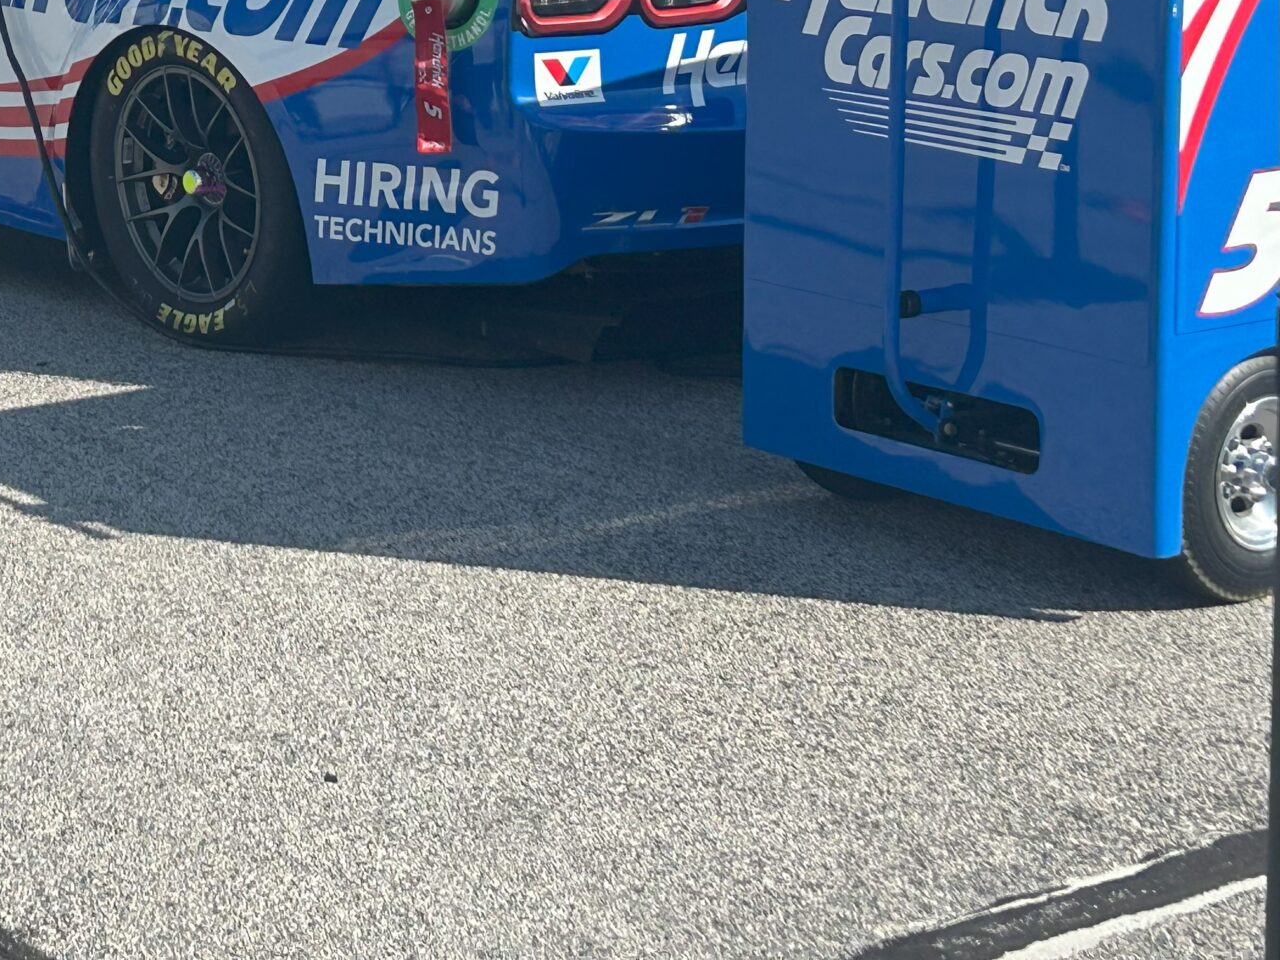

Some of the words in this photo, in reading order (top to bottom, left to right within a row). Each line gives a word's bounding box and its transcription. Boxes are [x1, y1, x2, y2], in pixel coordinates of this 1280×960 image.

[106, 30, 238, 96] GOODYEAR
[824, 16, 1090, 119] Cars.com
[423, 100, 443, 120] 5
[314, 158, 499, 219] HIRING
[314, 215, 497, 256] TECHNICIANS
[1199, 168, 1280, 317] 5
[157, 302, 226, 335] EAGLE
